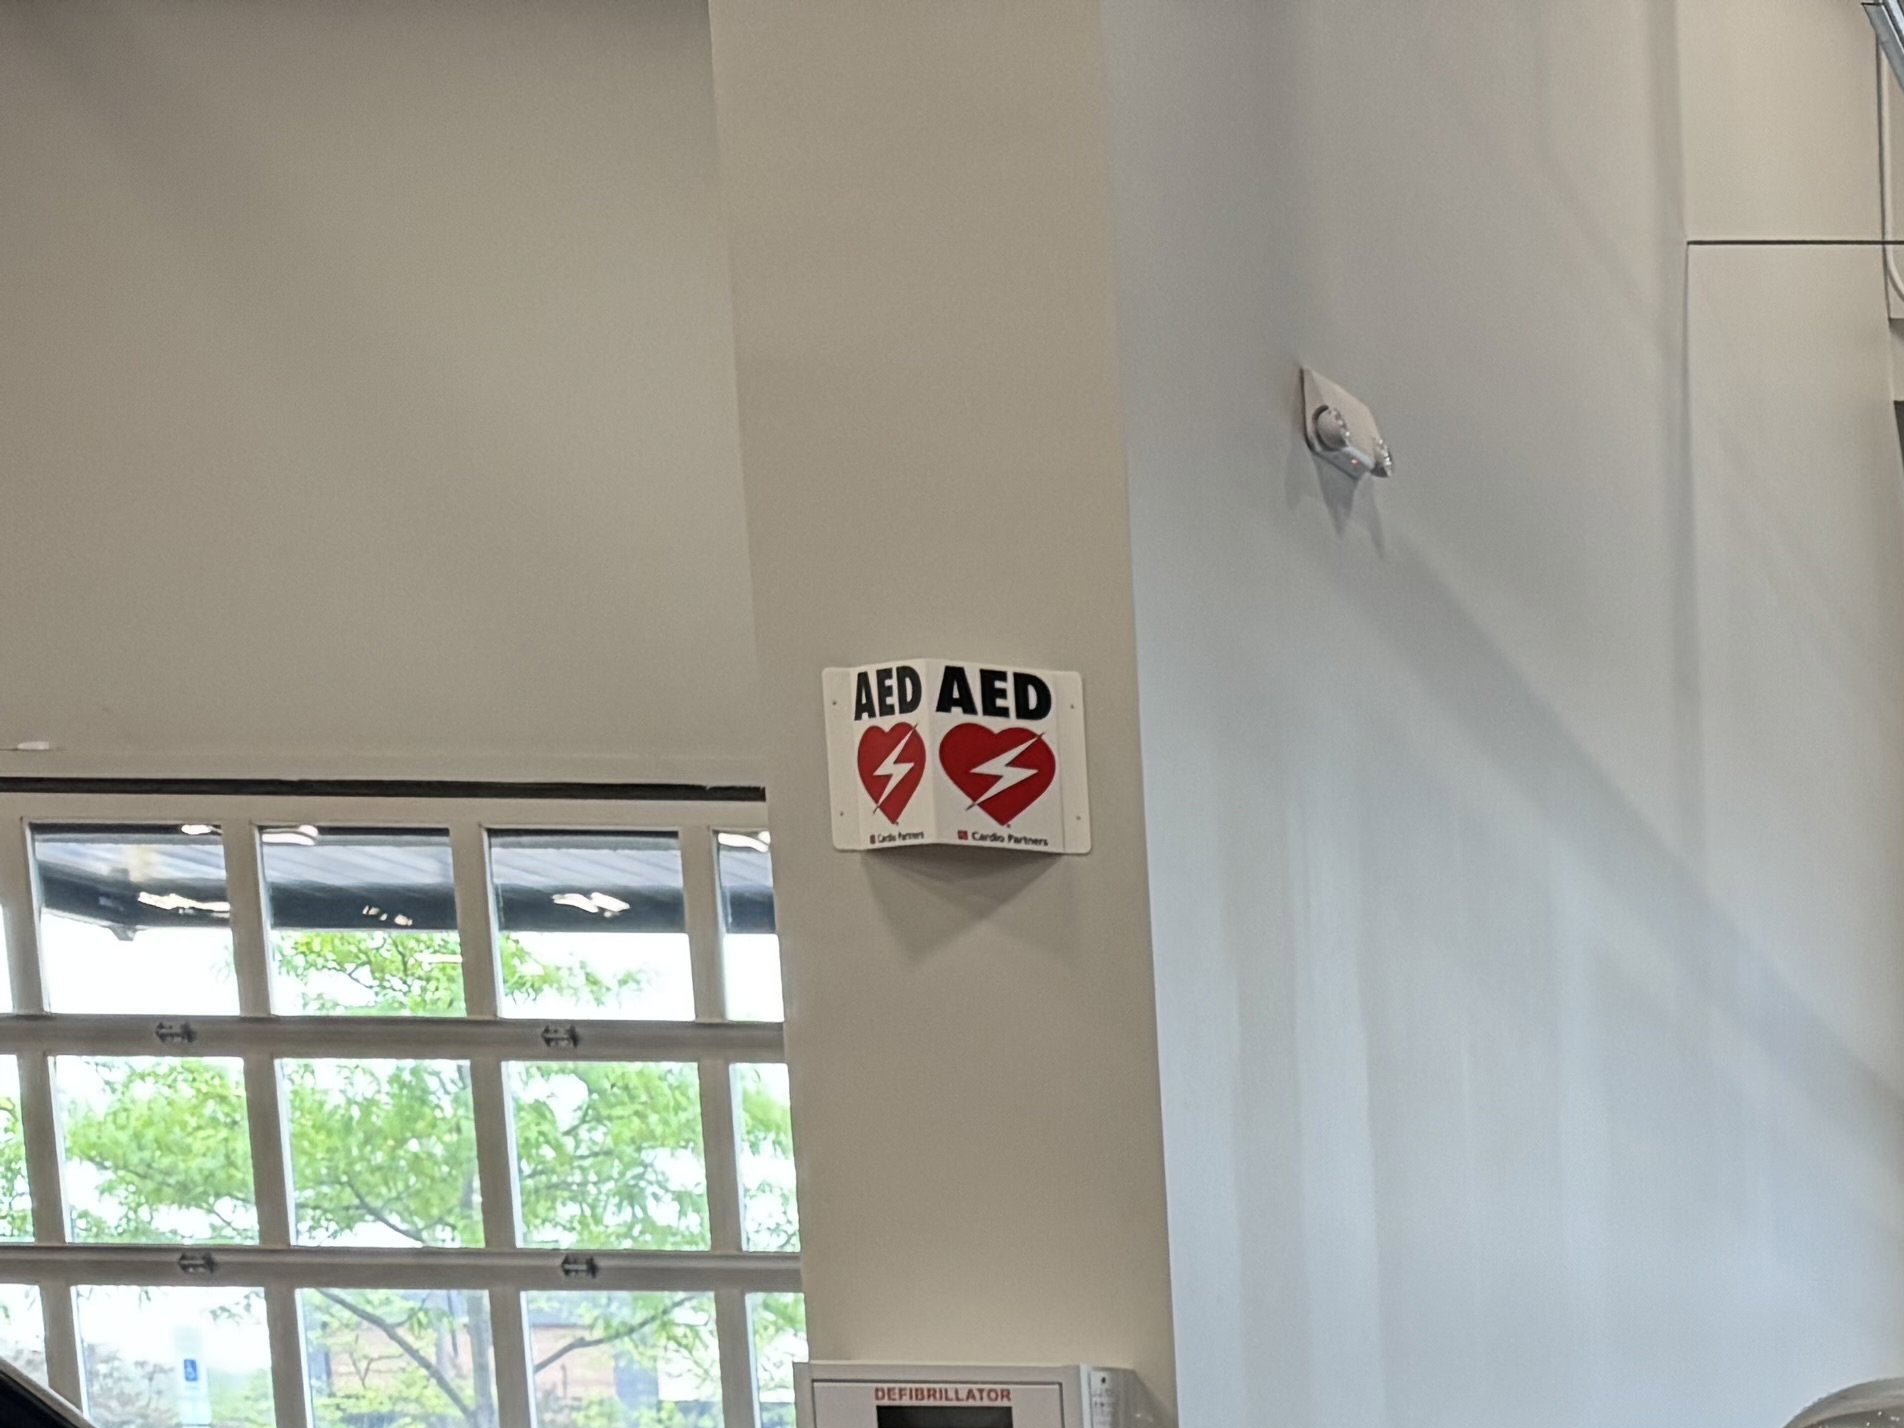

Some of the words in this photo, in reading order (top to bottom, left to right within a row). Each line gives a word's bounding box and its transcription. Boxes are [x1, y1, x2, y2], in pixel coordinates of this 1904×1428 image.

[853, 665, 923, 721] AED
[935, 665, 1053, 721] AED
[971, 831, 1005, 843] Cardio
[1007, 833, 1049, 847] Partners
[874, 1387, 1012, 1402] DEFIBRILLATOR
